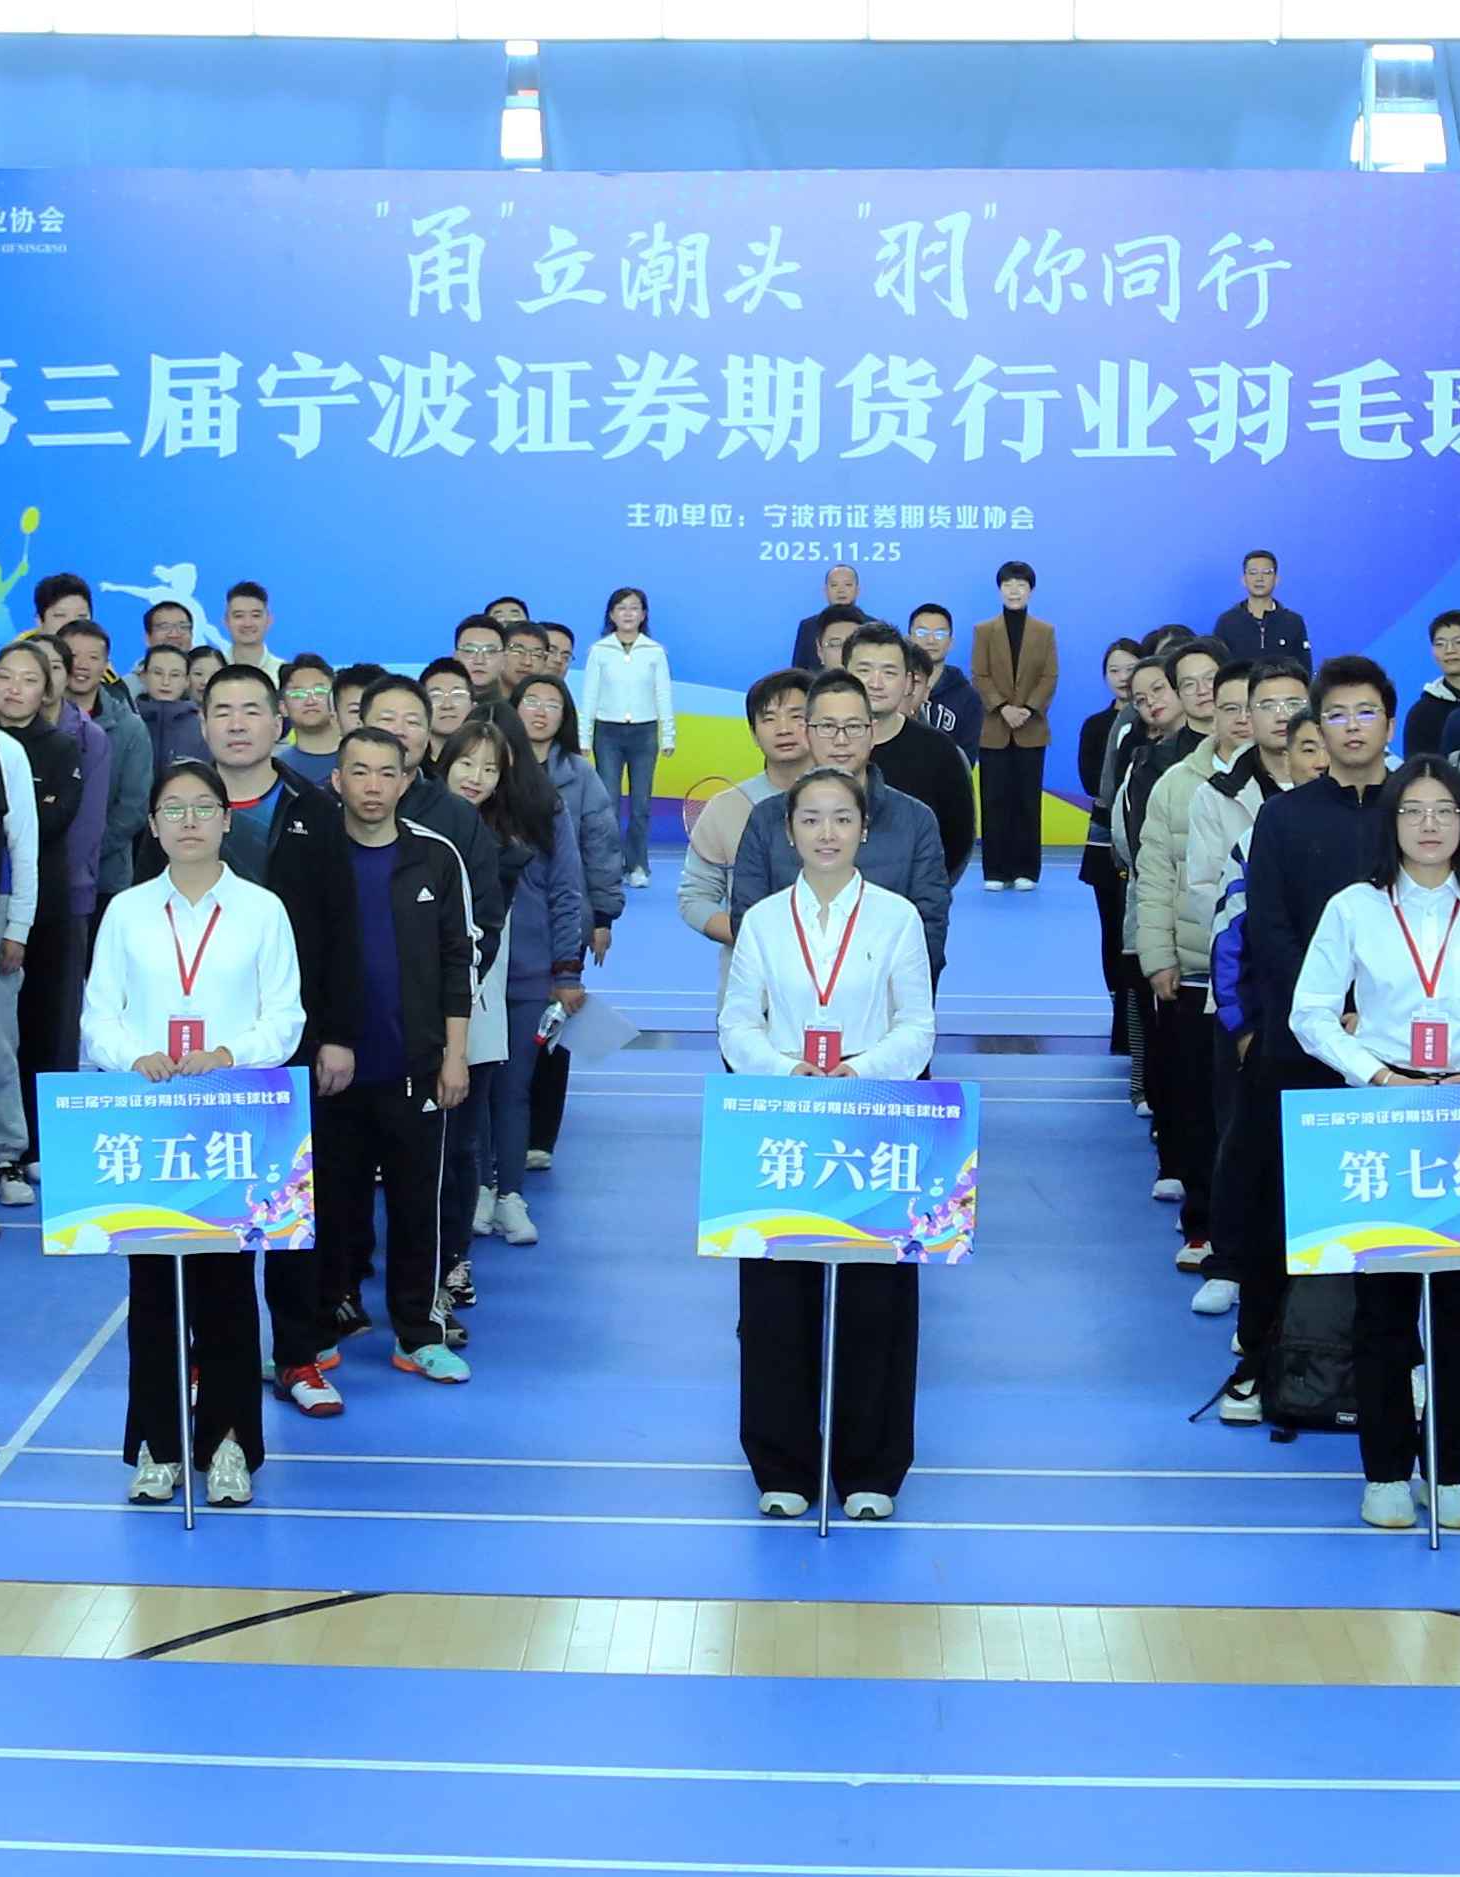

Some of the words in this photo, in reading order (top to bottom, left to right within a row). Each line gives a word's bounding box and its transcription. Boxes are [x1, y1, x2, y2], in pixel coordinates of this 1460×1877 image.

[758, 541, 902, 563] 2025.11.25
[92, 1130, 258, 1185] 第五组
[756, 1136, 922, 1193] 第六组
